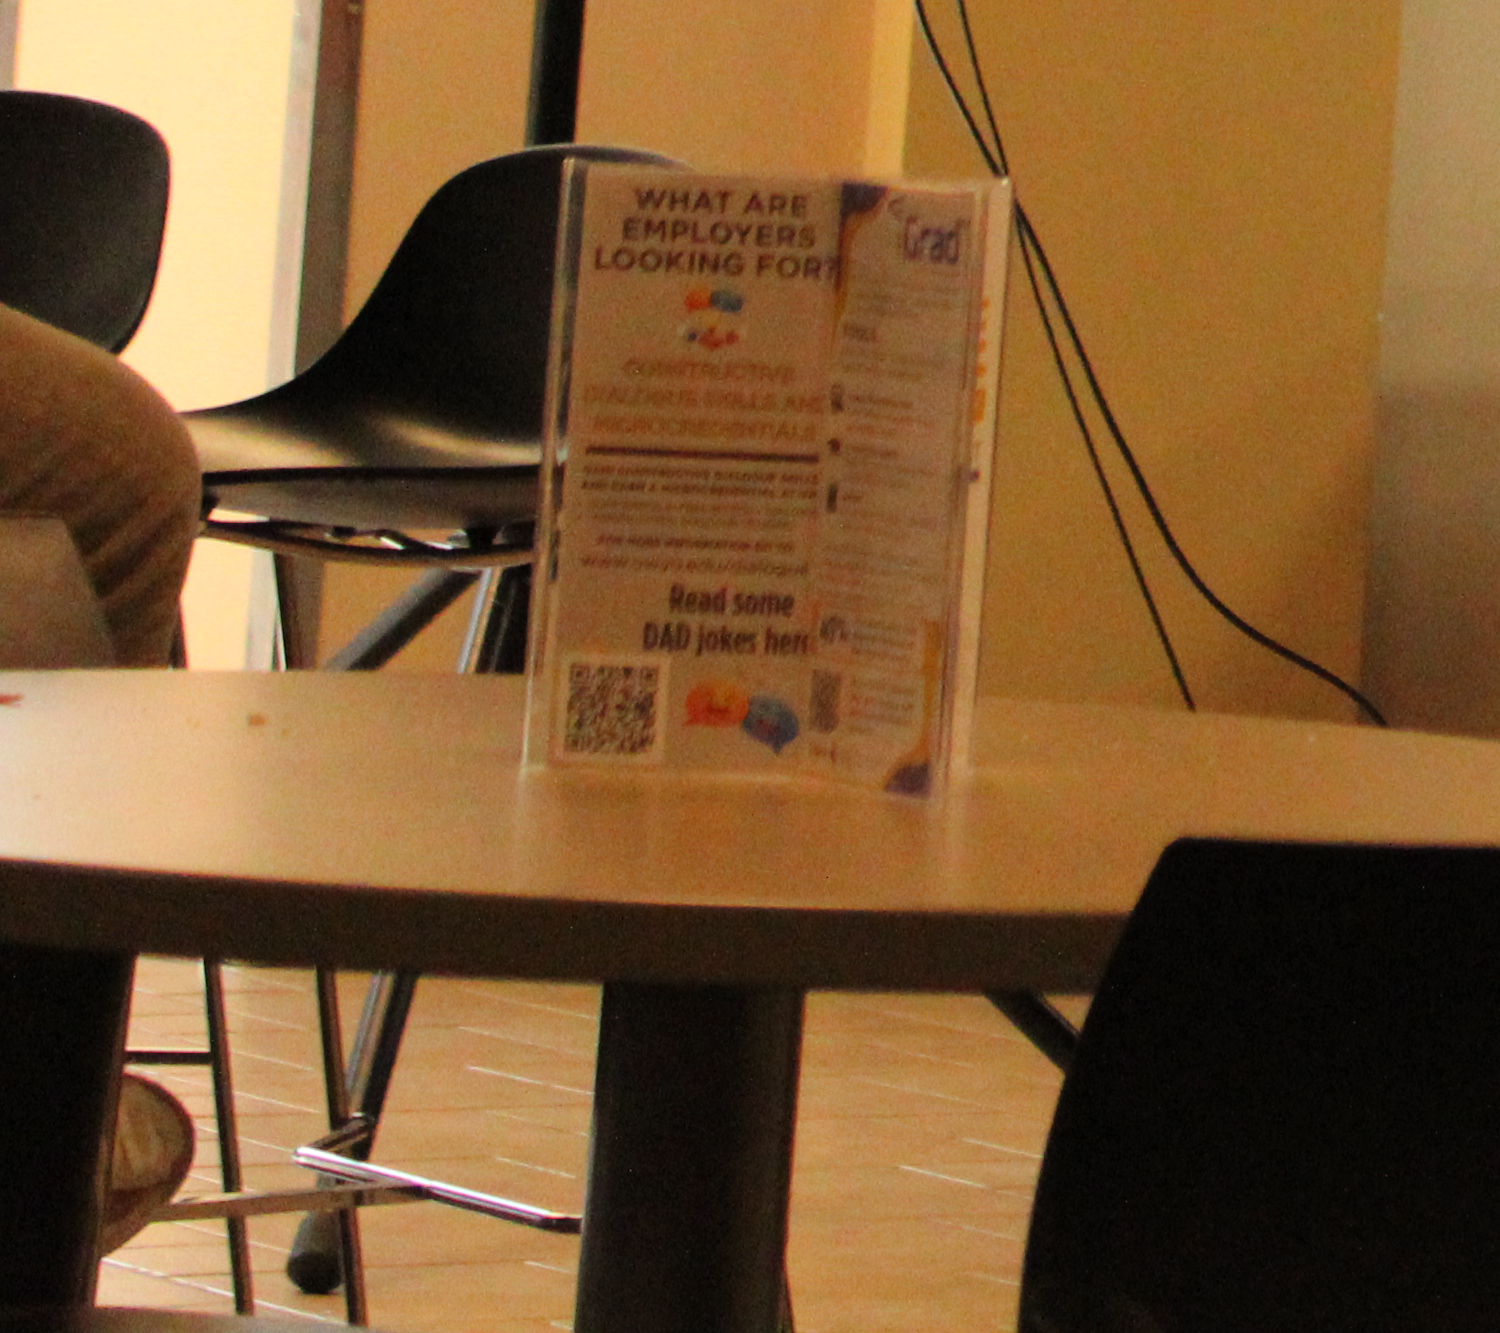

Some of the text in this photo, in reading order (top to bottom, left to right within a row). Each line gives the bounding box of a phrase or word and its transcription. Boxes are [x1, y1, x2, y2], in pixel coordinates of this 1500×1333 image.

[635, 188, 808, 217] WHAT ARE
[623, 216, 815, 249] EMPLOYERS
[595, 247, 745, 277] LOOKING
[670, 584, 795, 618] Read some
[643, 621, 692, 652] DAD
[697, 624, 756, 656] jokes
